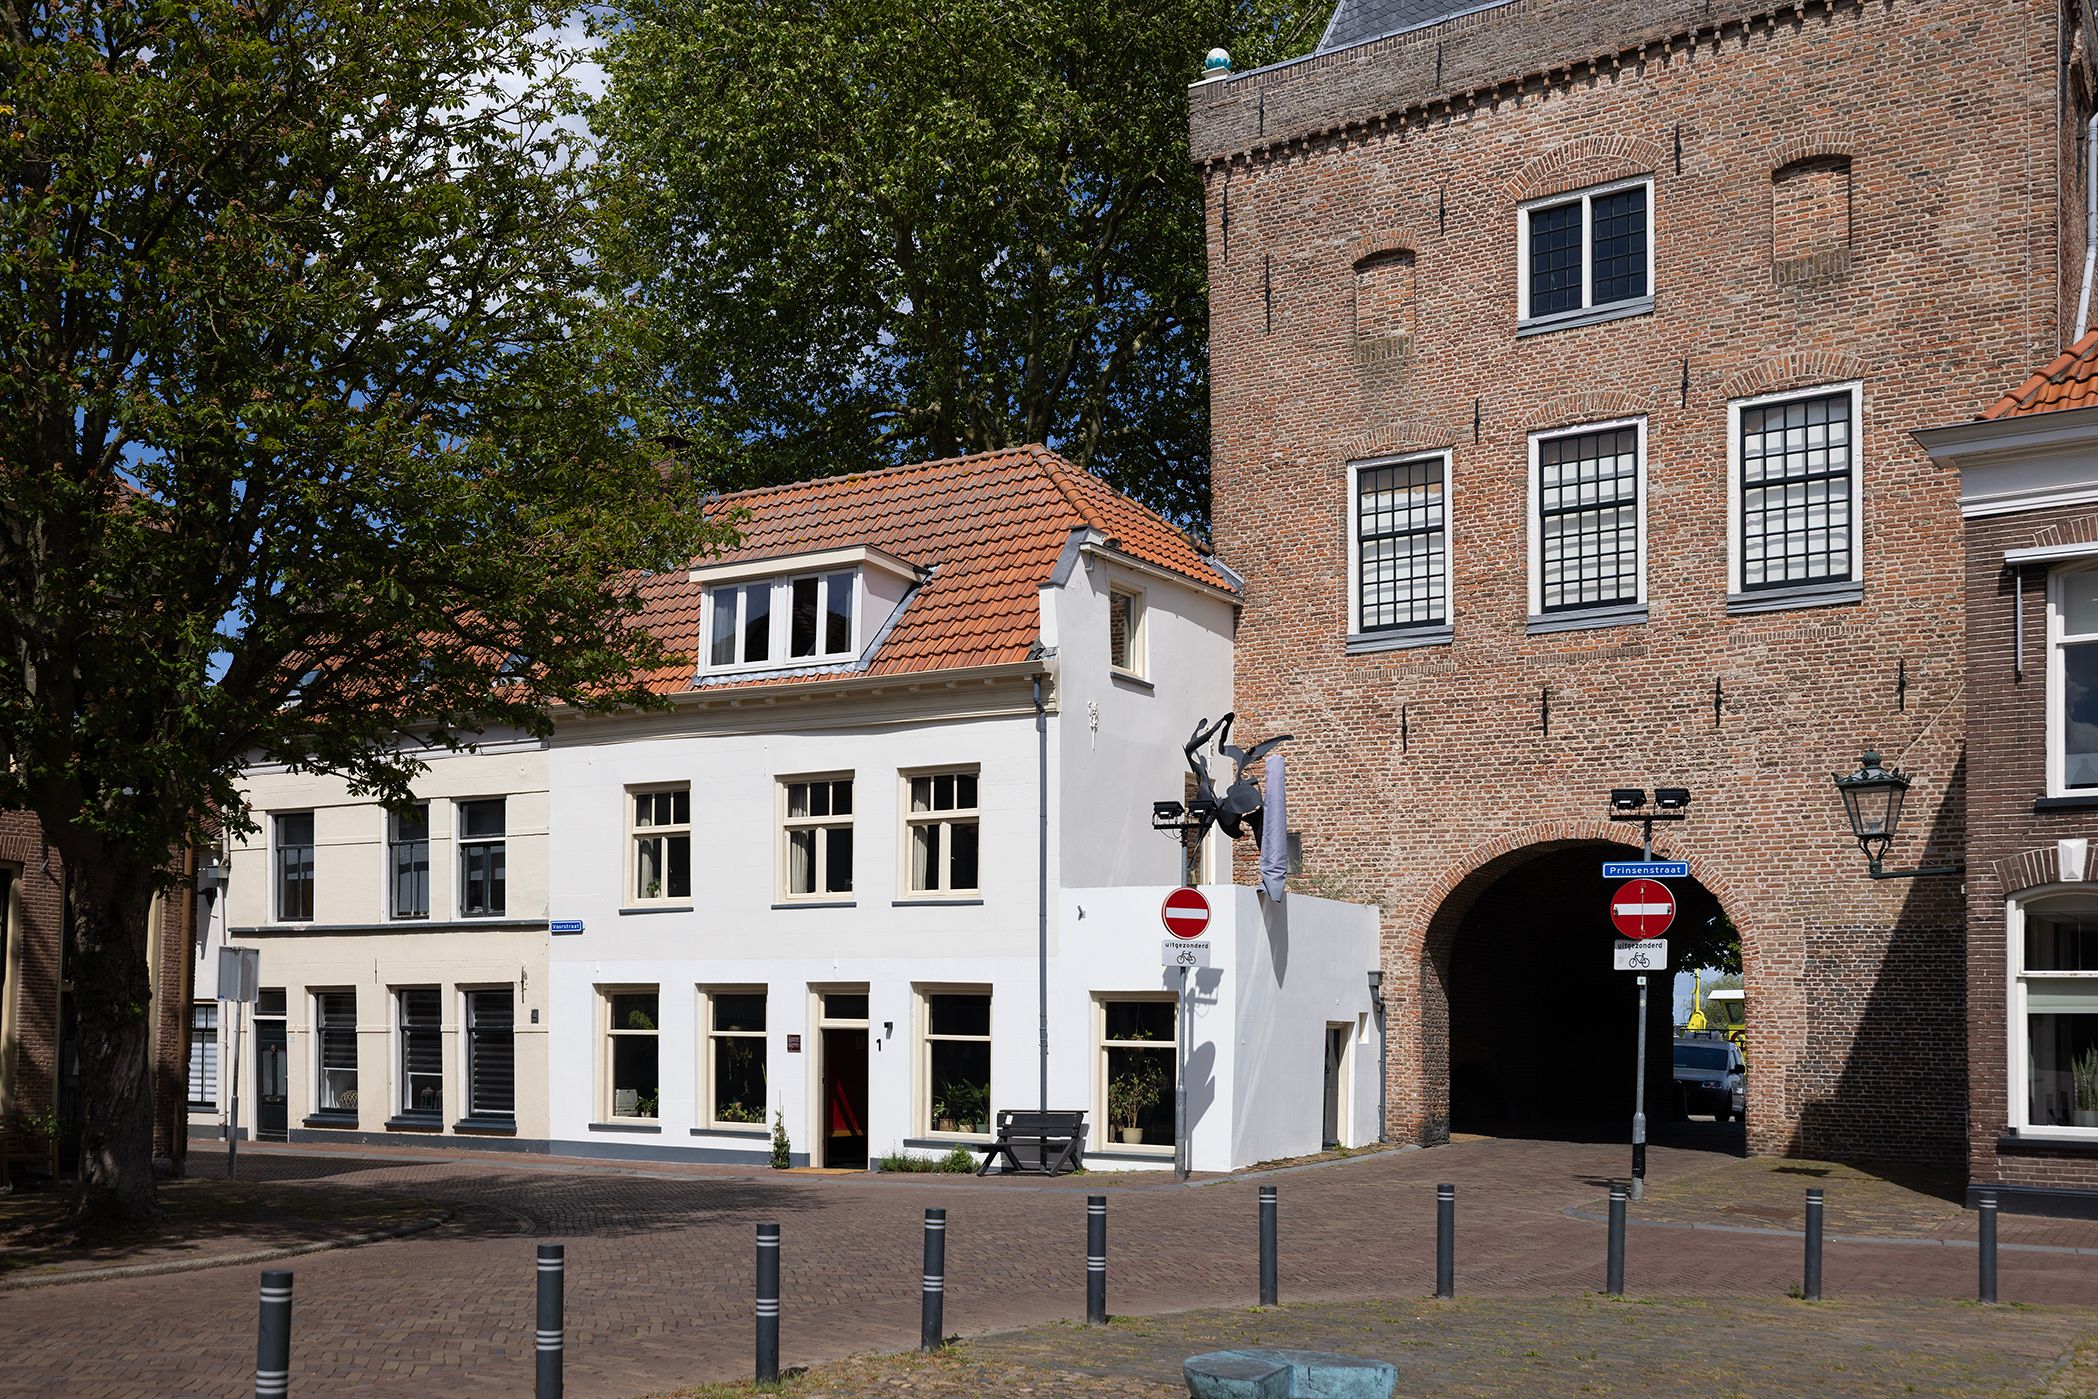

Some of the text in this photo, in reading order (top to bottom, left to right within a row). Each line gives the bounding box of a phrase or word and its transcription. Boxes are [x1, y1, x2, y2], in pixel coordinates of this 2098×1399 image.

[1610, 866, 1681, 874] Prinsenstraat
[1617, 942, 1663, 950] uitgezonderd
[876, 1038, 882, 1052] 1
